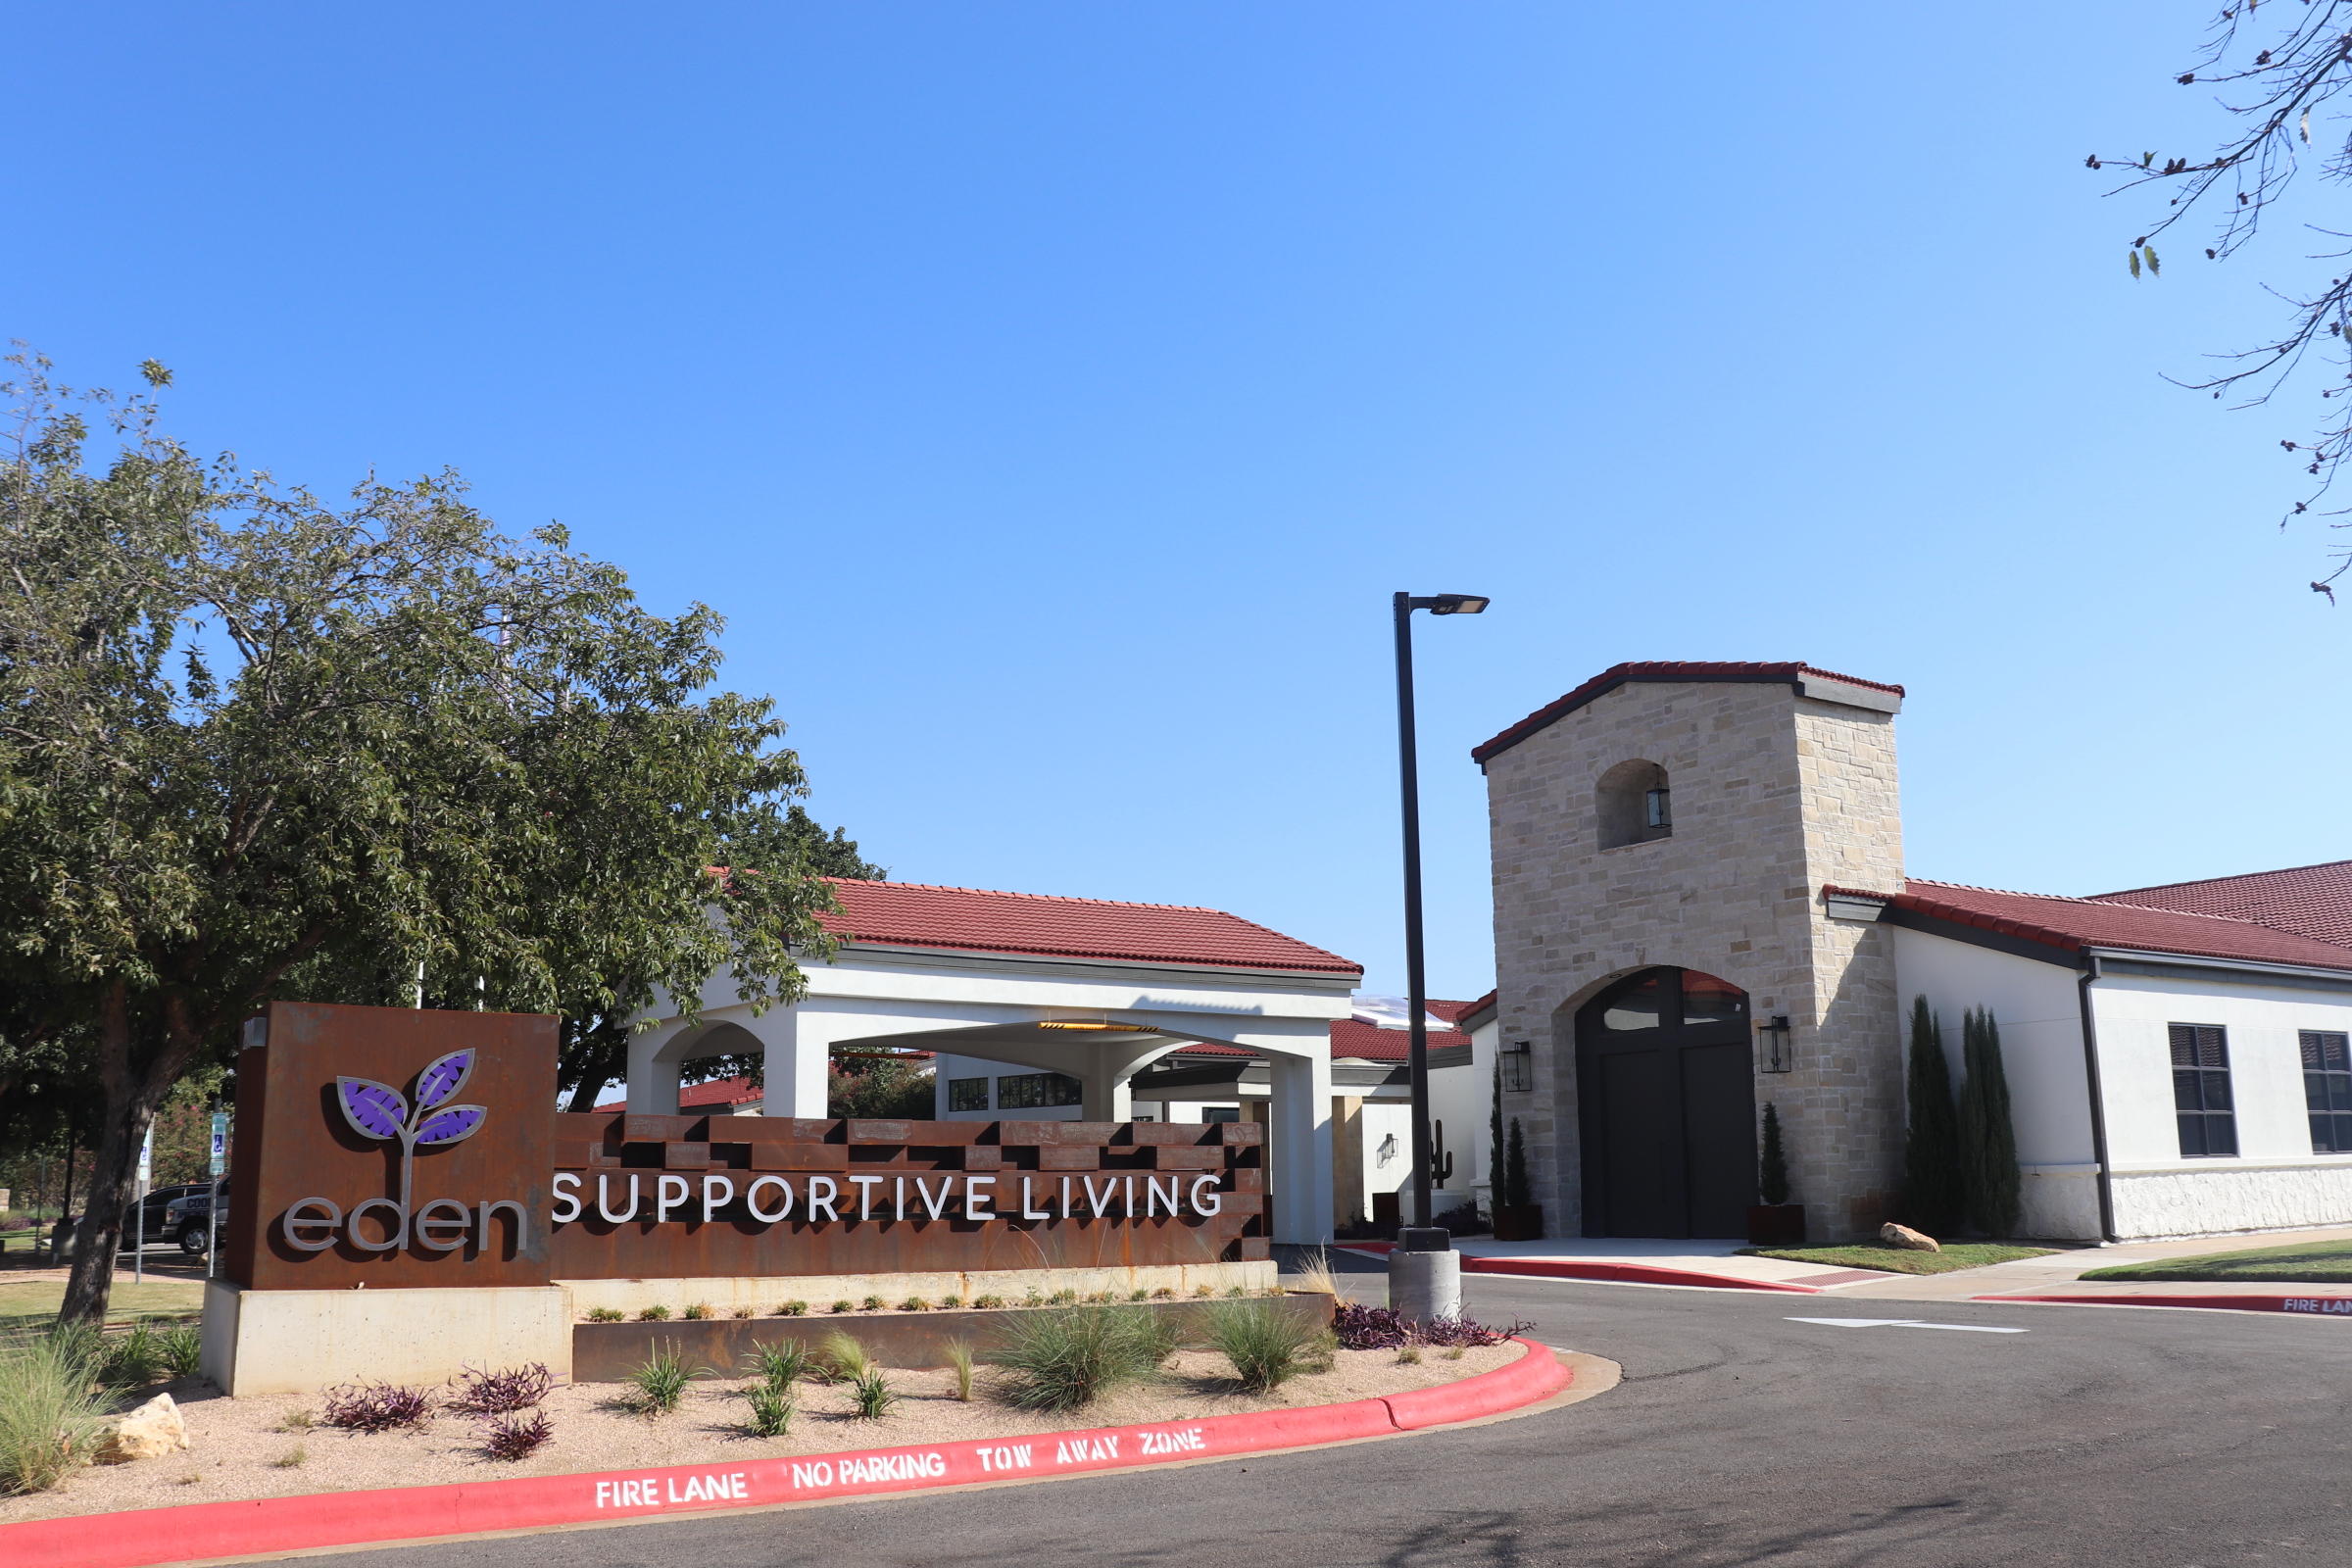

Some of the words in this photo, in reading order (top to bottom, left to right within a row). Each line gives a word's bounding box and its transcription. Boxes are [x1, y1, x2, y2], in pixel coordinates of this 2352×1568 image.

[282, 1142, 528, 1252] eden
[551, 1173, 997, 1224] SUPPORTIVE
[1023, 1174, 1222, 1221] LIVING
[2283, 1298, 2319, 1312] FIRE
[595, 1479, 660, 1508] FIRE
[667, 1472, 749, 1503] LANE
[792, 1461, 834, 1490] NO
[839, 1452, 947, 1485] PARKING
[976, 1444, 1032, 1472] TOW
[1055, 1435, 1119, 1465] AWAY
[1137, 1427, 1207, 1455] ZONE
